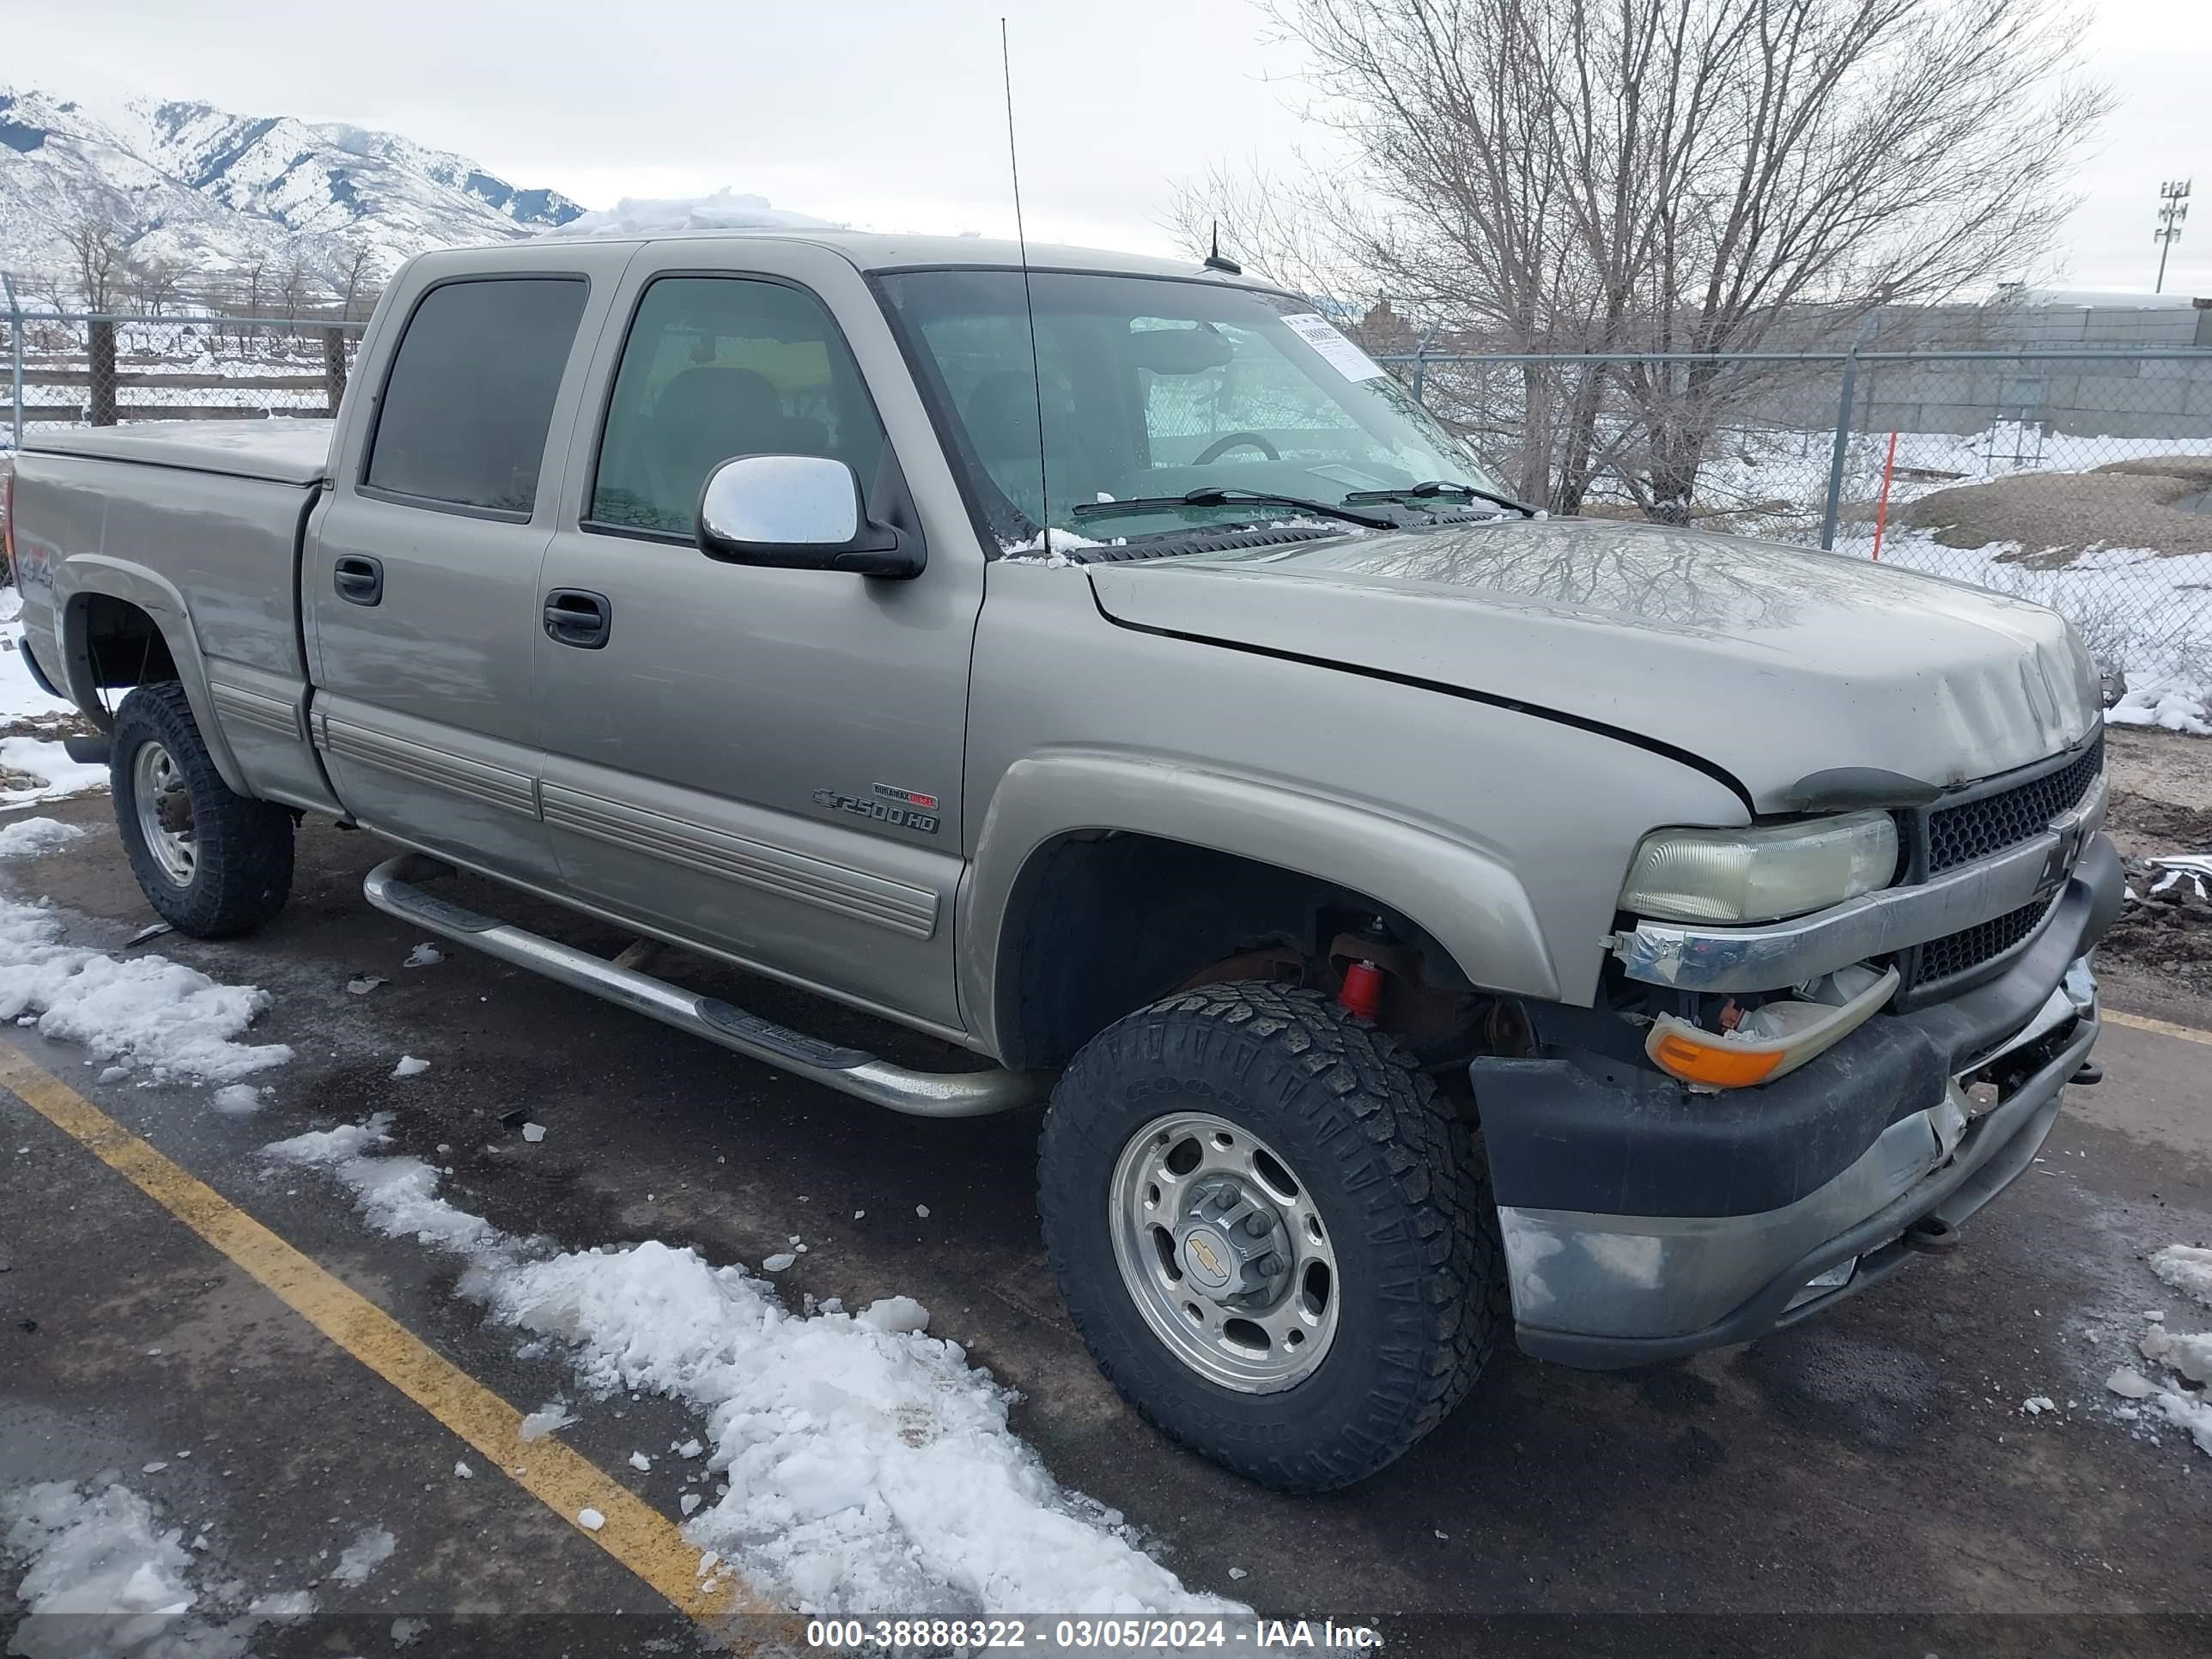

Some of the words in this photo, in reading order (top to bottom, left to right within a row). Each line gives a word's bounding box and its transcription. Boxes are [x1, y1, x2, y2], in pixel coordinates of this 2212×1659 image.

[874, 785, 909, 800] DURAMAX
[909, 794, 934, 807] DIESEL
[842, 796, 904, 825] 2500
[907, 812, 935, 832] HD
